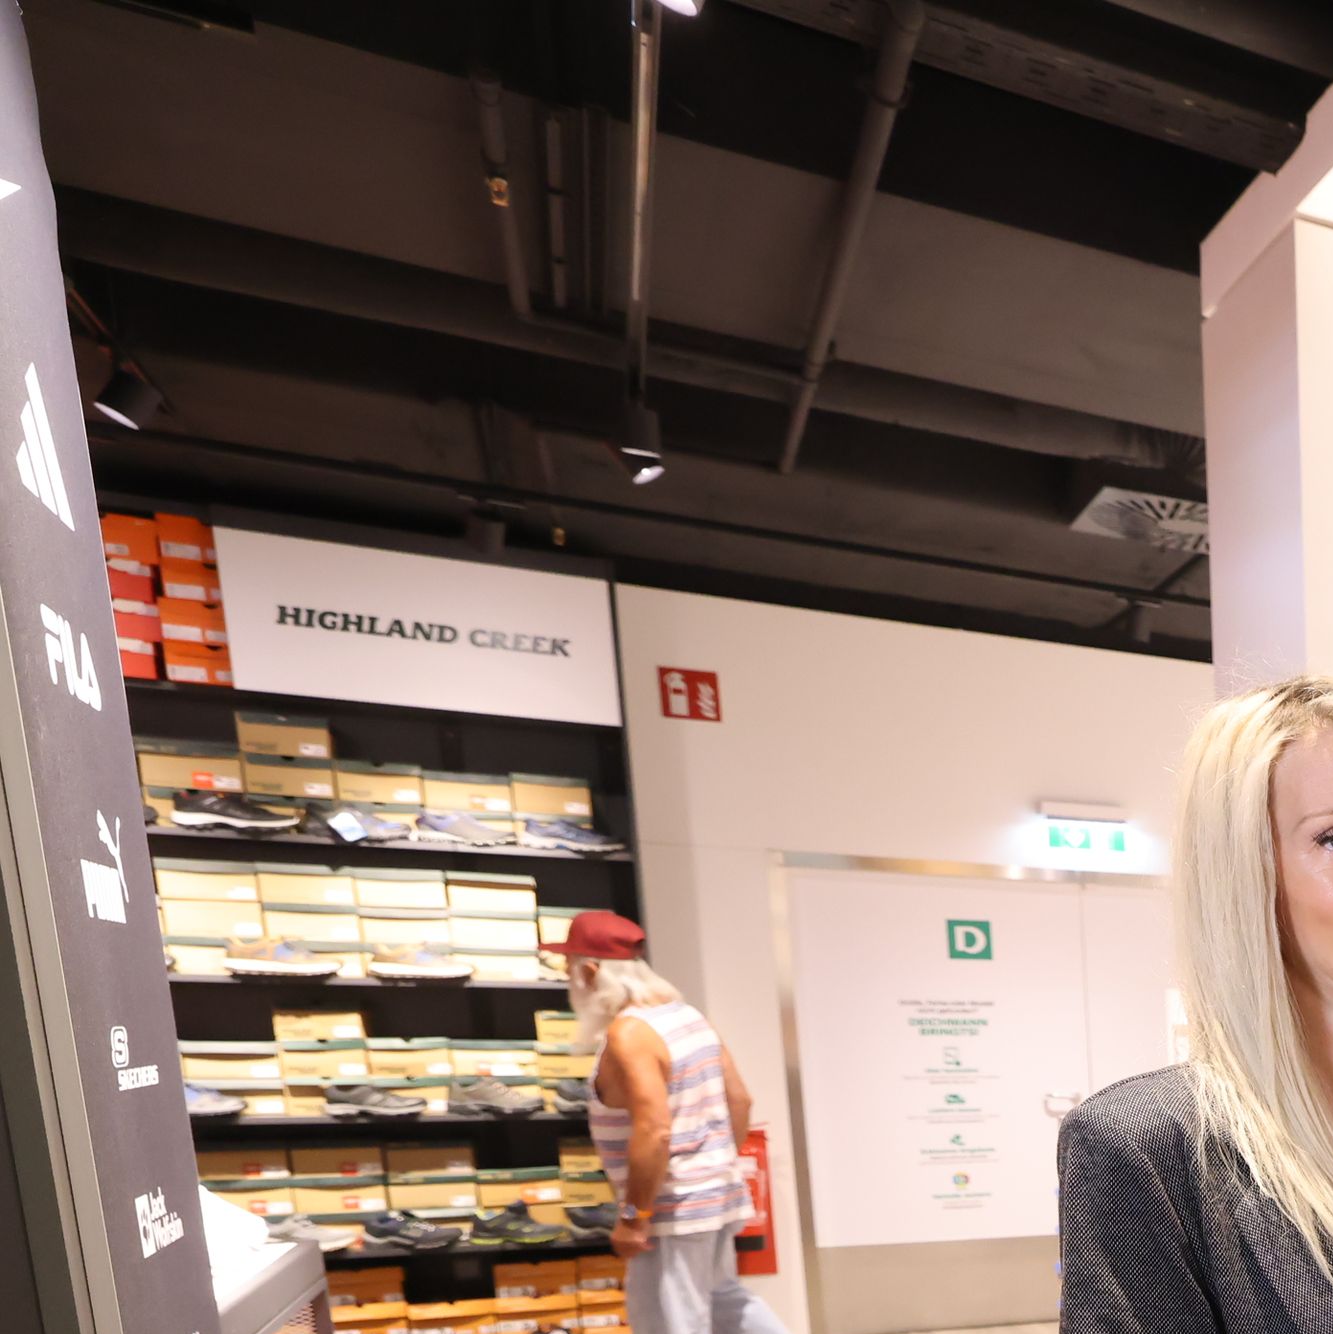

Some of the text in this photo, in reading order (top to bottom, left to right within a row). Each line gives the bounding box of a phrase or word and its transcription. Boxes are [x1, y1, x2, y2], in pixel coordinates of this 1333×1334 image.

[276, 603, 573, 658] HIGHLAND CREEK
[40, 603, 102, 711] FILA
[954, 924, 988, 955] D
[149, 1186, 168, 1221] Jack
